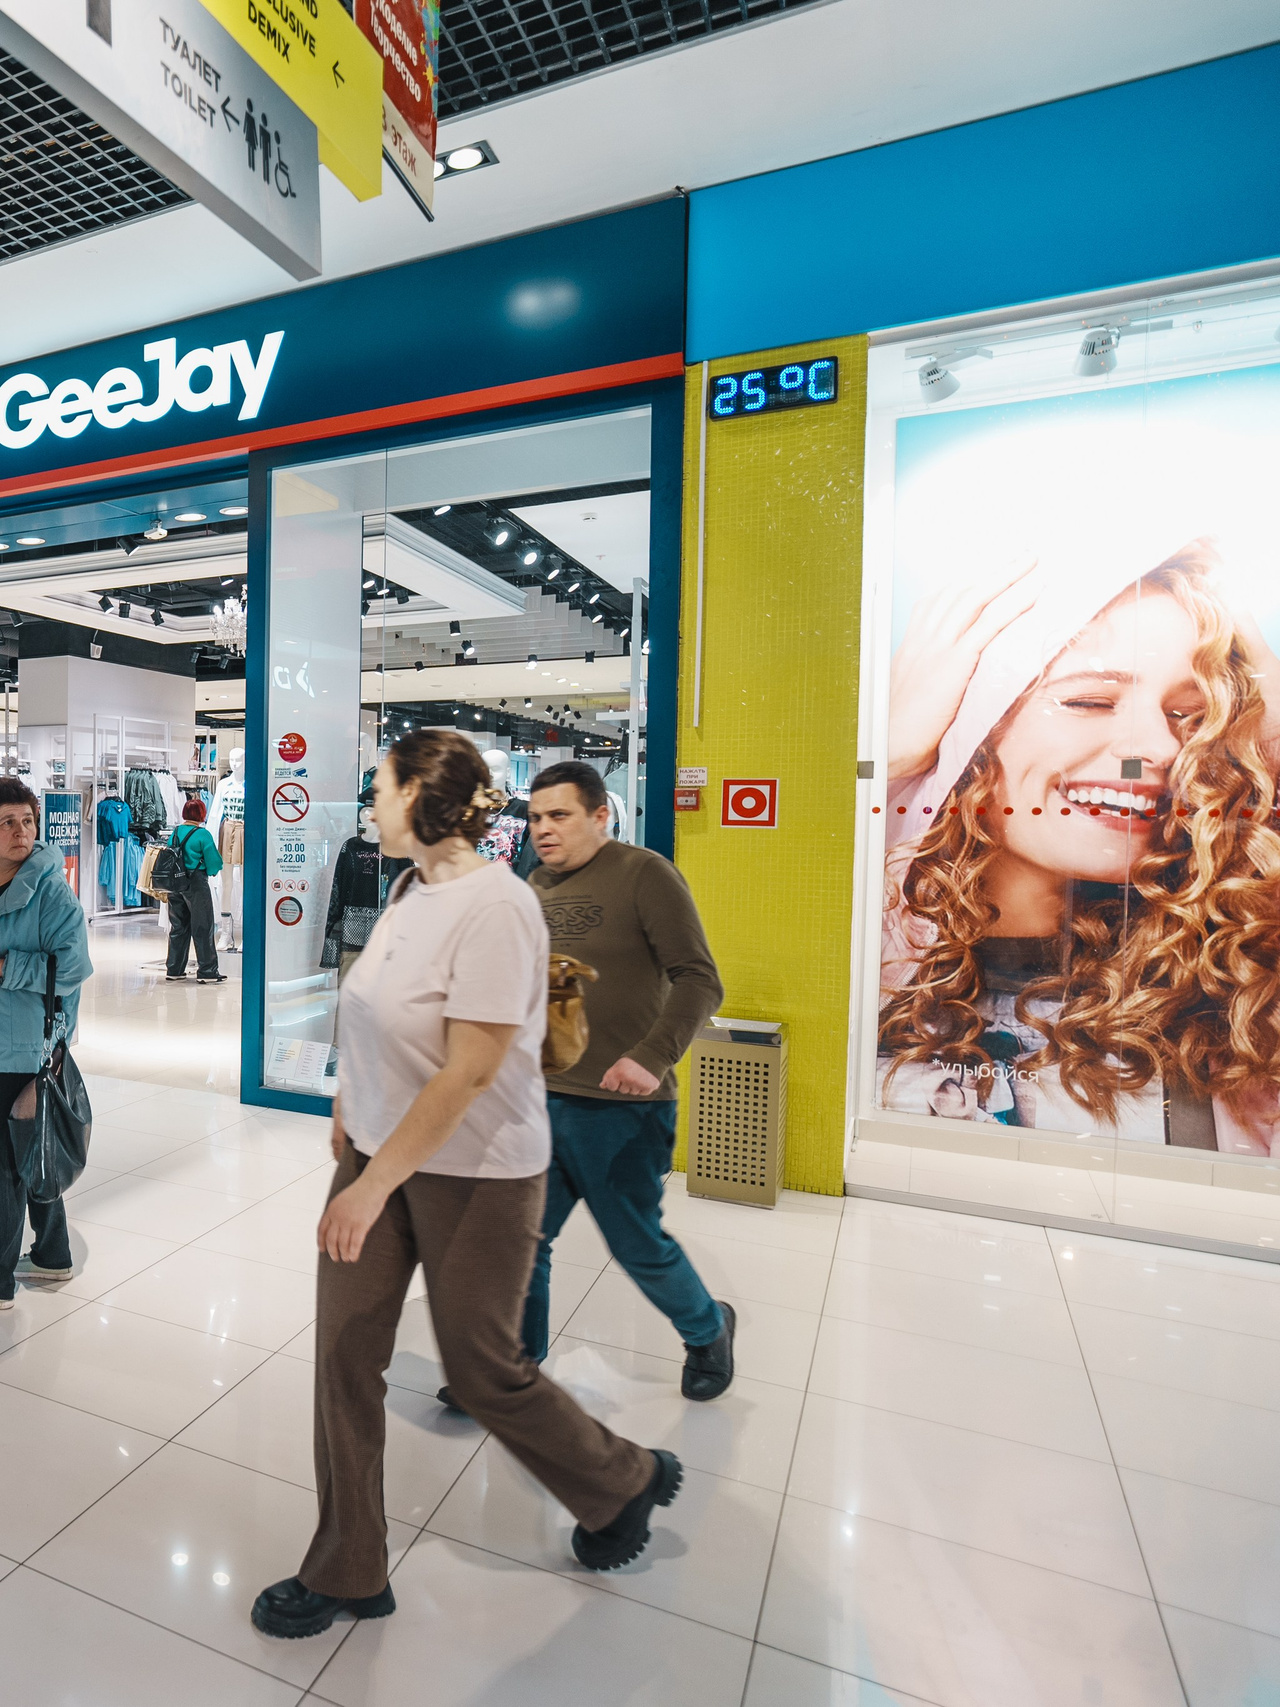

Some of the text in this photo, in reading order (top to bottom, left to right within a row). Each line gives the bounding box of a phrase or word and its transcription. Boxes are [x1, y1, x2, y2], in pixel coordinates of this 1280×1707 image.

[159, 16, 221, 93] ТУАЛЕТ
[248, 0, 290, 64] DEMIX
[266, 0, 316, 58] LUSIVE
[375, 0, 418, 67] коделие
[160, 61, 216, 128] TOILET
[391, 125, 417, 176] этаж
[714, 371, 766, 415] 25
[49, 812, 79, 824] МОДНАЯ
[49, 826, 79, 838] ОДЕЖДА
[283, 843, 305, 852] 10.00
[283, 854, 306, 863] 22.00
